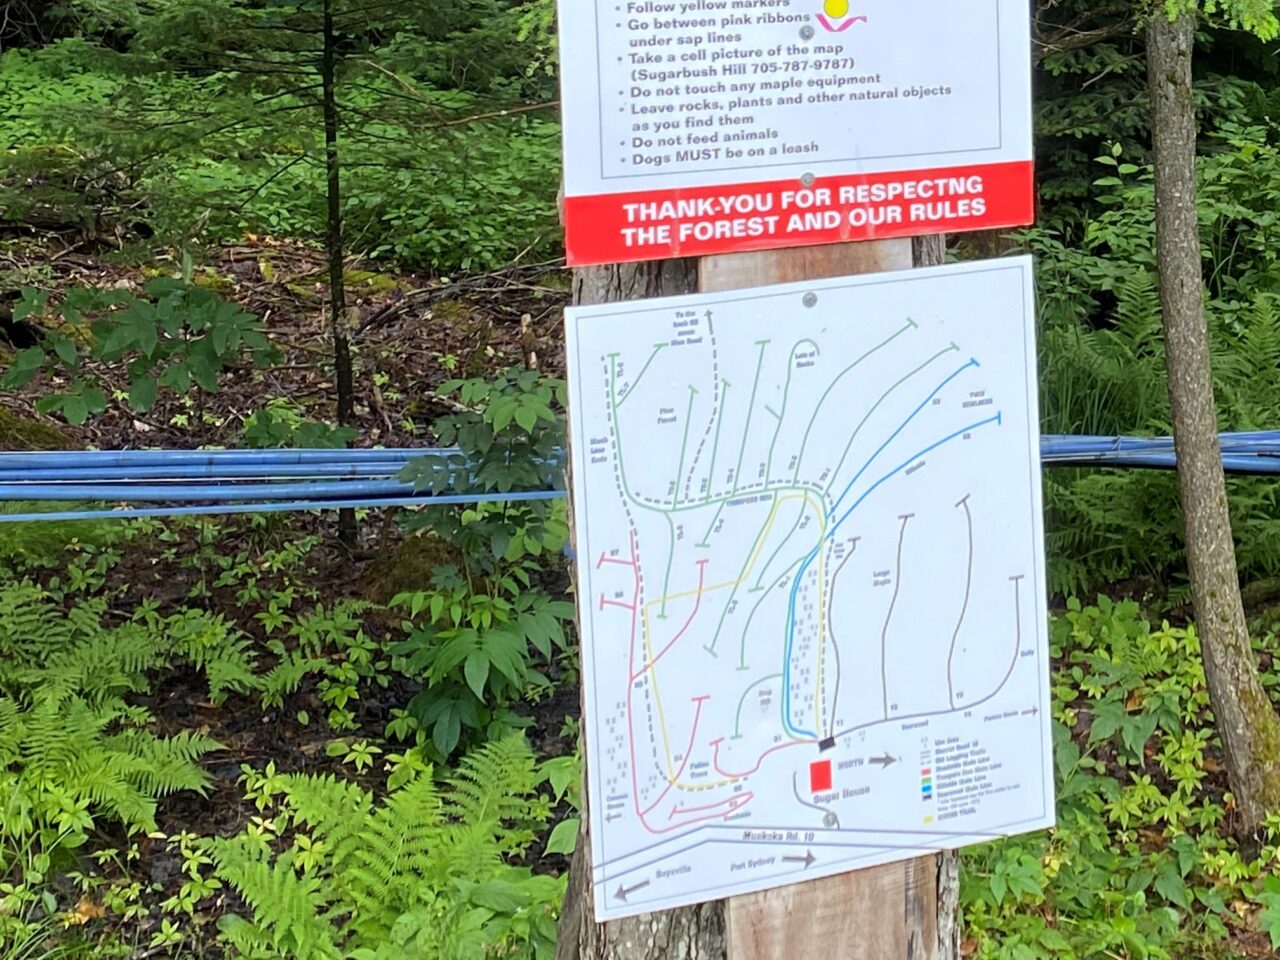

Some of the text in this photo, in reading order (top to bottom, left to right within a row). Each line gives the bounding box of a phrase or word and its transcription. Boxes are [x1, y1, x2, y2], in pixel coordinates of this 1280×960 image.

[627, 2, 675, 13] Follow
[680, 0, 726, 14] yellow
[628, 13, 811, 30] Go between pink ribbons
[630, 32, 741, 47] under sap lines
[628, 53, 662, 64] Take
[681, 49, 706, 61] cell
[712, 48, 763, 62] picture
[767, 45, 781, 56] of
[787, 44, 809, 55] the
[814, 45, 844, 56] map
[631, 59, 854, 82] (Sugarbush Hill 705-787-9787)
[631, 74, 880, 97] Do not touch any maple equipment
[631, 86, 951, 114] Leave rocks, plants and other natural objects
[632, 115, 753, 132] as you find them
[632, 128, 778, 148] Do not feed animals
[633, 141, 818, 166] Dogs MUST be on a leash
[623, 176, 982, 221] THANK-YOU FOR RESPECTNG
[621, 198, 986, 246] THE FOREST AND OUR RULES
[813, 785, 870, 805] Sugar House
[743, 831, 815, 841] Muskoka Rd. 10
